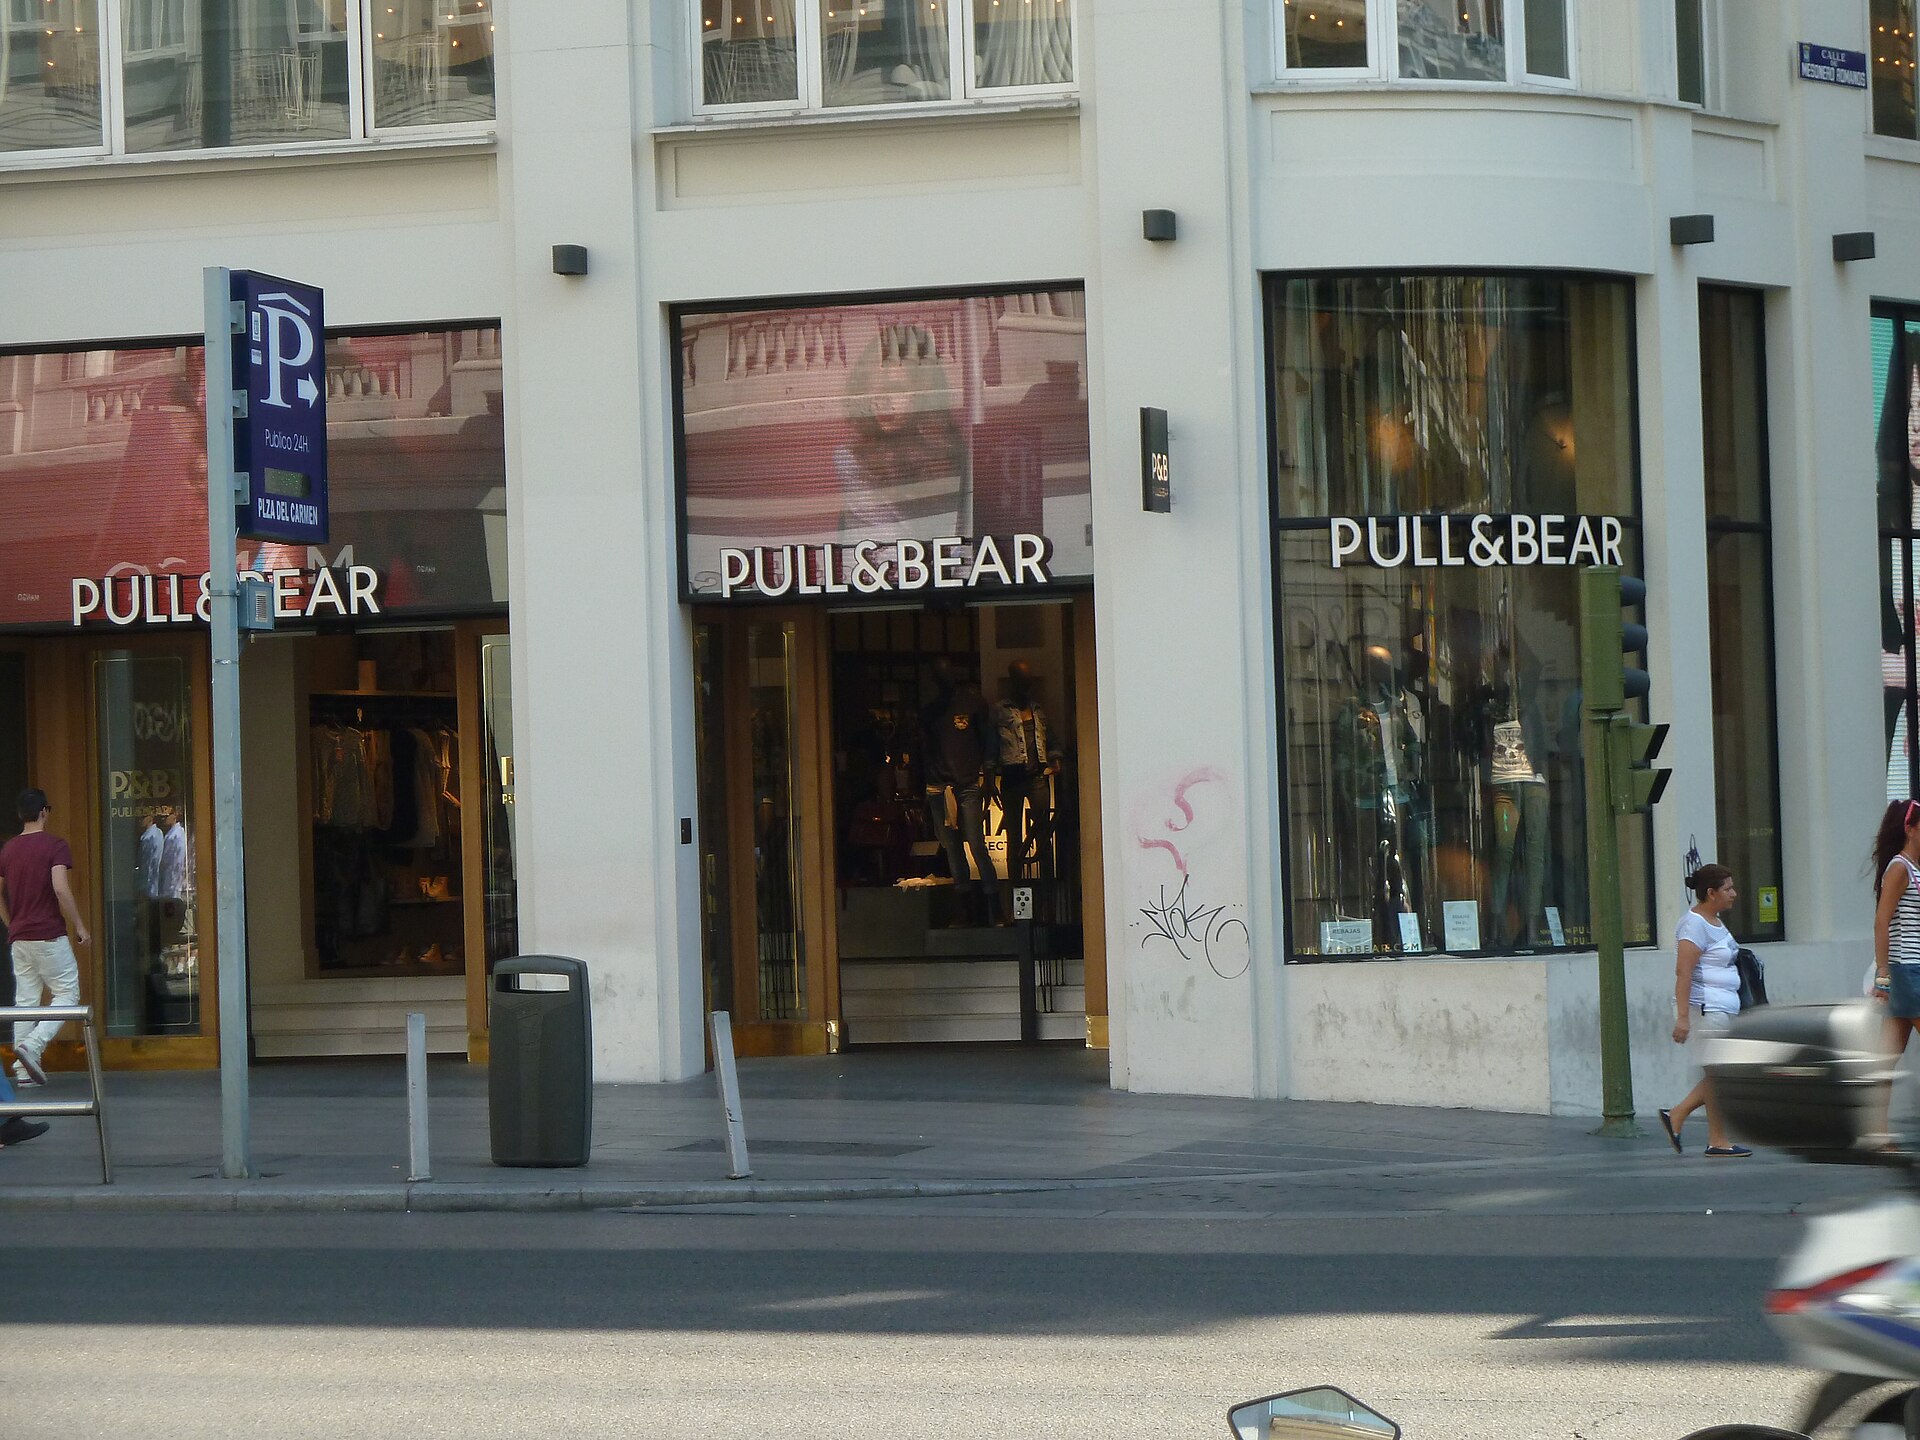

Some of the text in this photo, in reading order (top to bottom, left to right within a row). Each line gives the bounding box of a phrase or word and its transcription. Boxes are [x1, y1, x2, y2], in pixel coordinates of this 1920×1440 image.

[1821, 49, 1846, 62] CALLE
[1152, 452, 1168, 481] P&B
[257, 498, 318, 525] PLZA DEL CARMEN
[1331, 513, 1623, 569] PULL&BEAR
[720, 533, 1048, 598] PULL&BEAR
